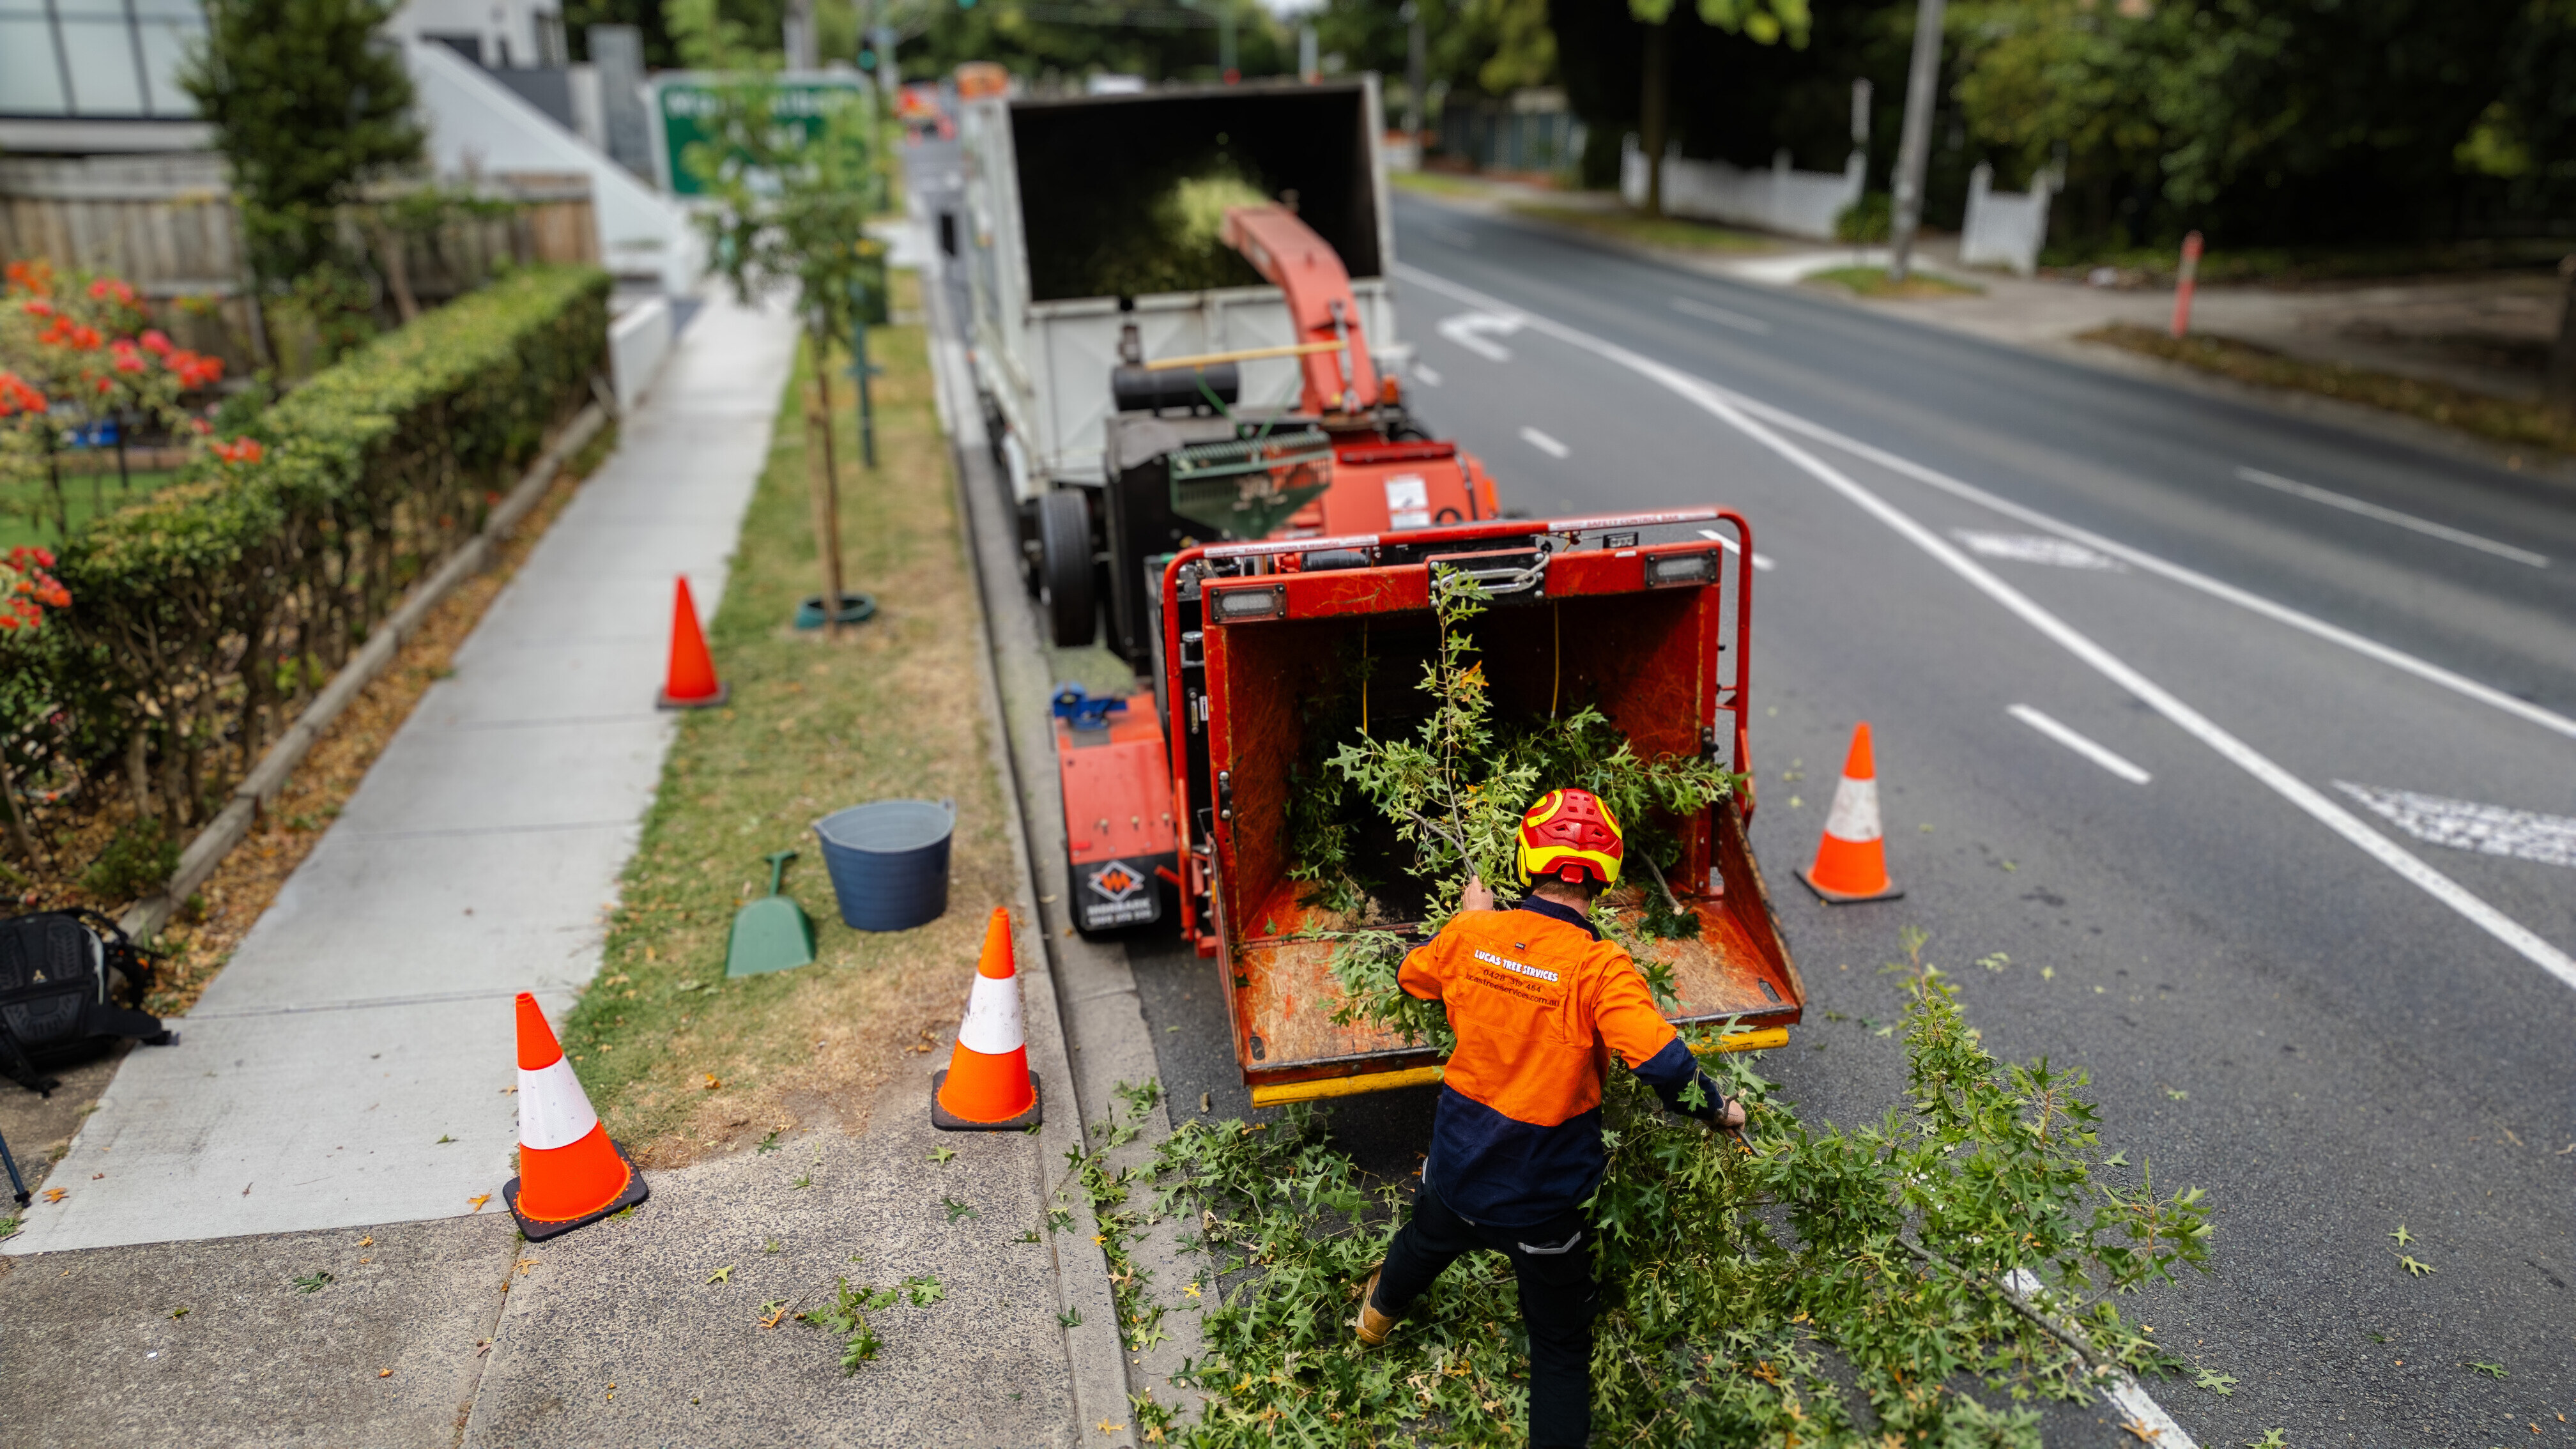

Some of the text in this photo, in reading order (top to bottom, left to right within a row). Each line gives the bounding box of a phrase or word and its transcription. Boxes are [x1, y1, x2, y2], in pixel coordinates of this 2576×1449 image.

[1586, 520, 1618, 528] SAFETY
[1620, 517, 1658, 526] CONTROL
[1474, 949, 1558, 982] LUCAS TREE SERVICES
[1483, 969, 1505, 981] 0428
[1509, 977, 1523, 987] 319
